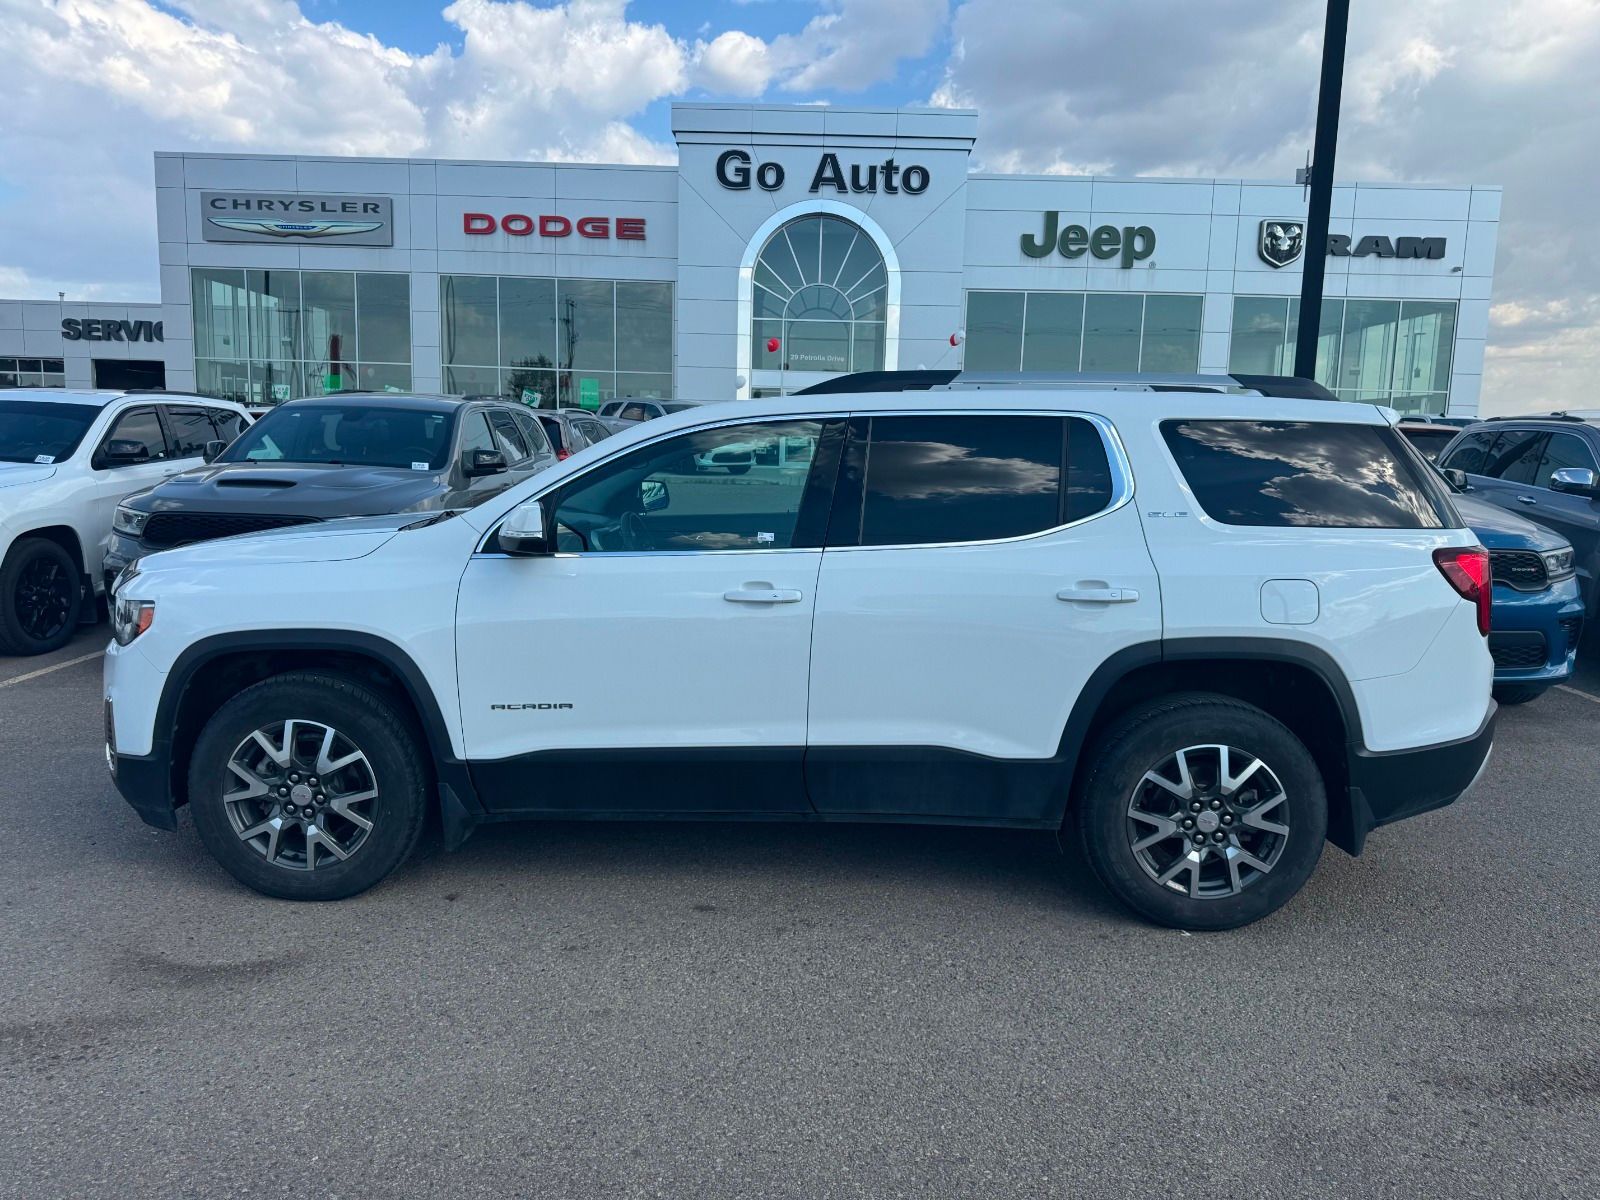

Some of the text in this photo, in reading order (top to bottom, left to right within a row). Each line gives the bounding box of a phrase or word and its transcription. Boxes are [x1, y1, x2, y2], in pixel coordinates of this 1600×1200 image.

[716, 149, 930, 195] Go Auto
[210, 197, 380, 214] CHRYSLER
[464, 213, 646, 240] DODGE
[1021, 210, 1156, 269] Jeep
[1326, 234, 1447, 259] RAM
